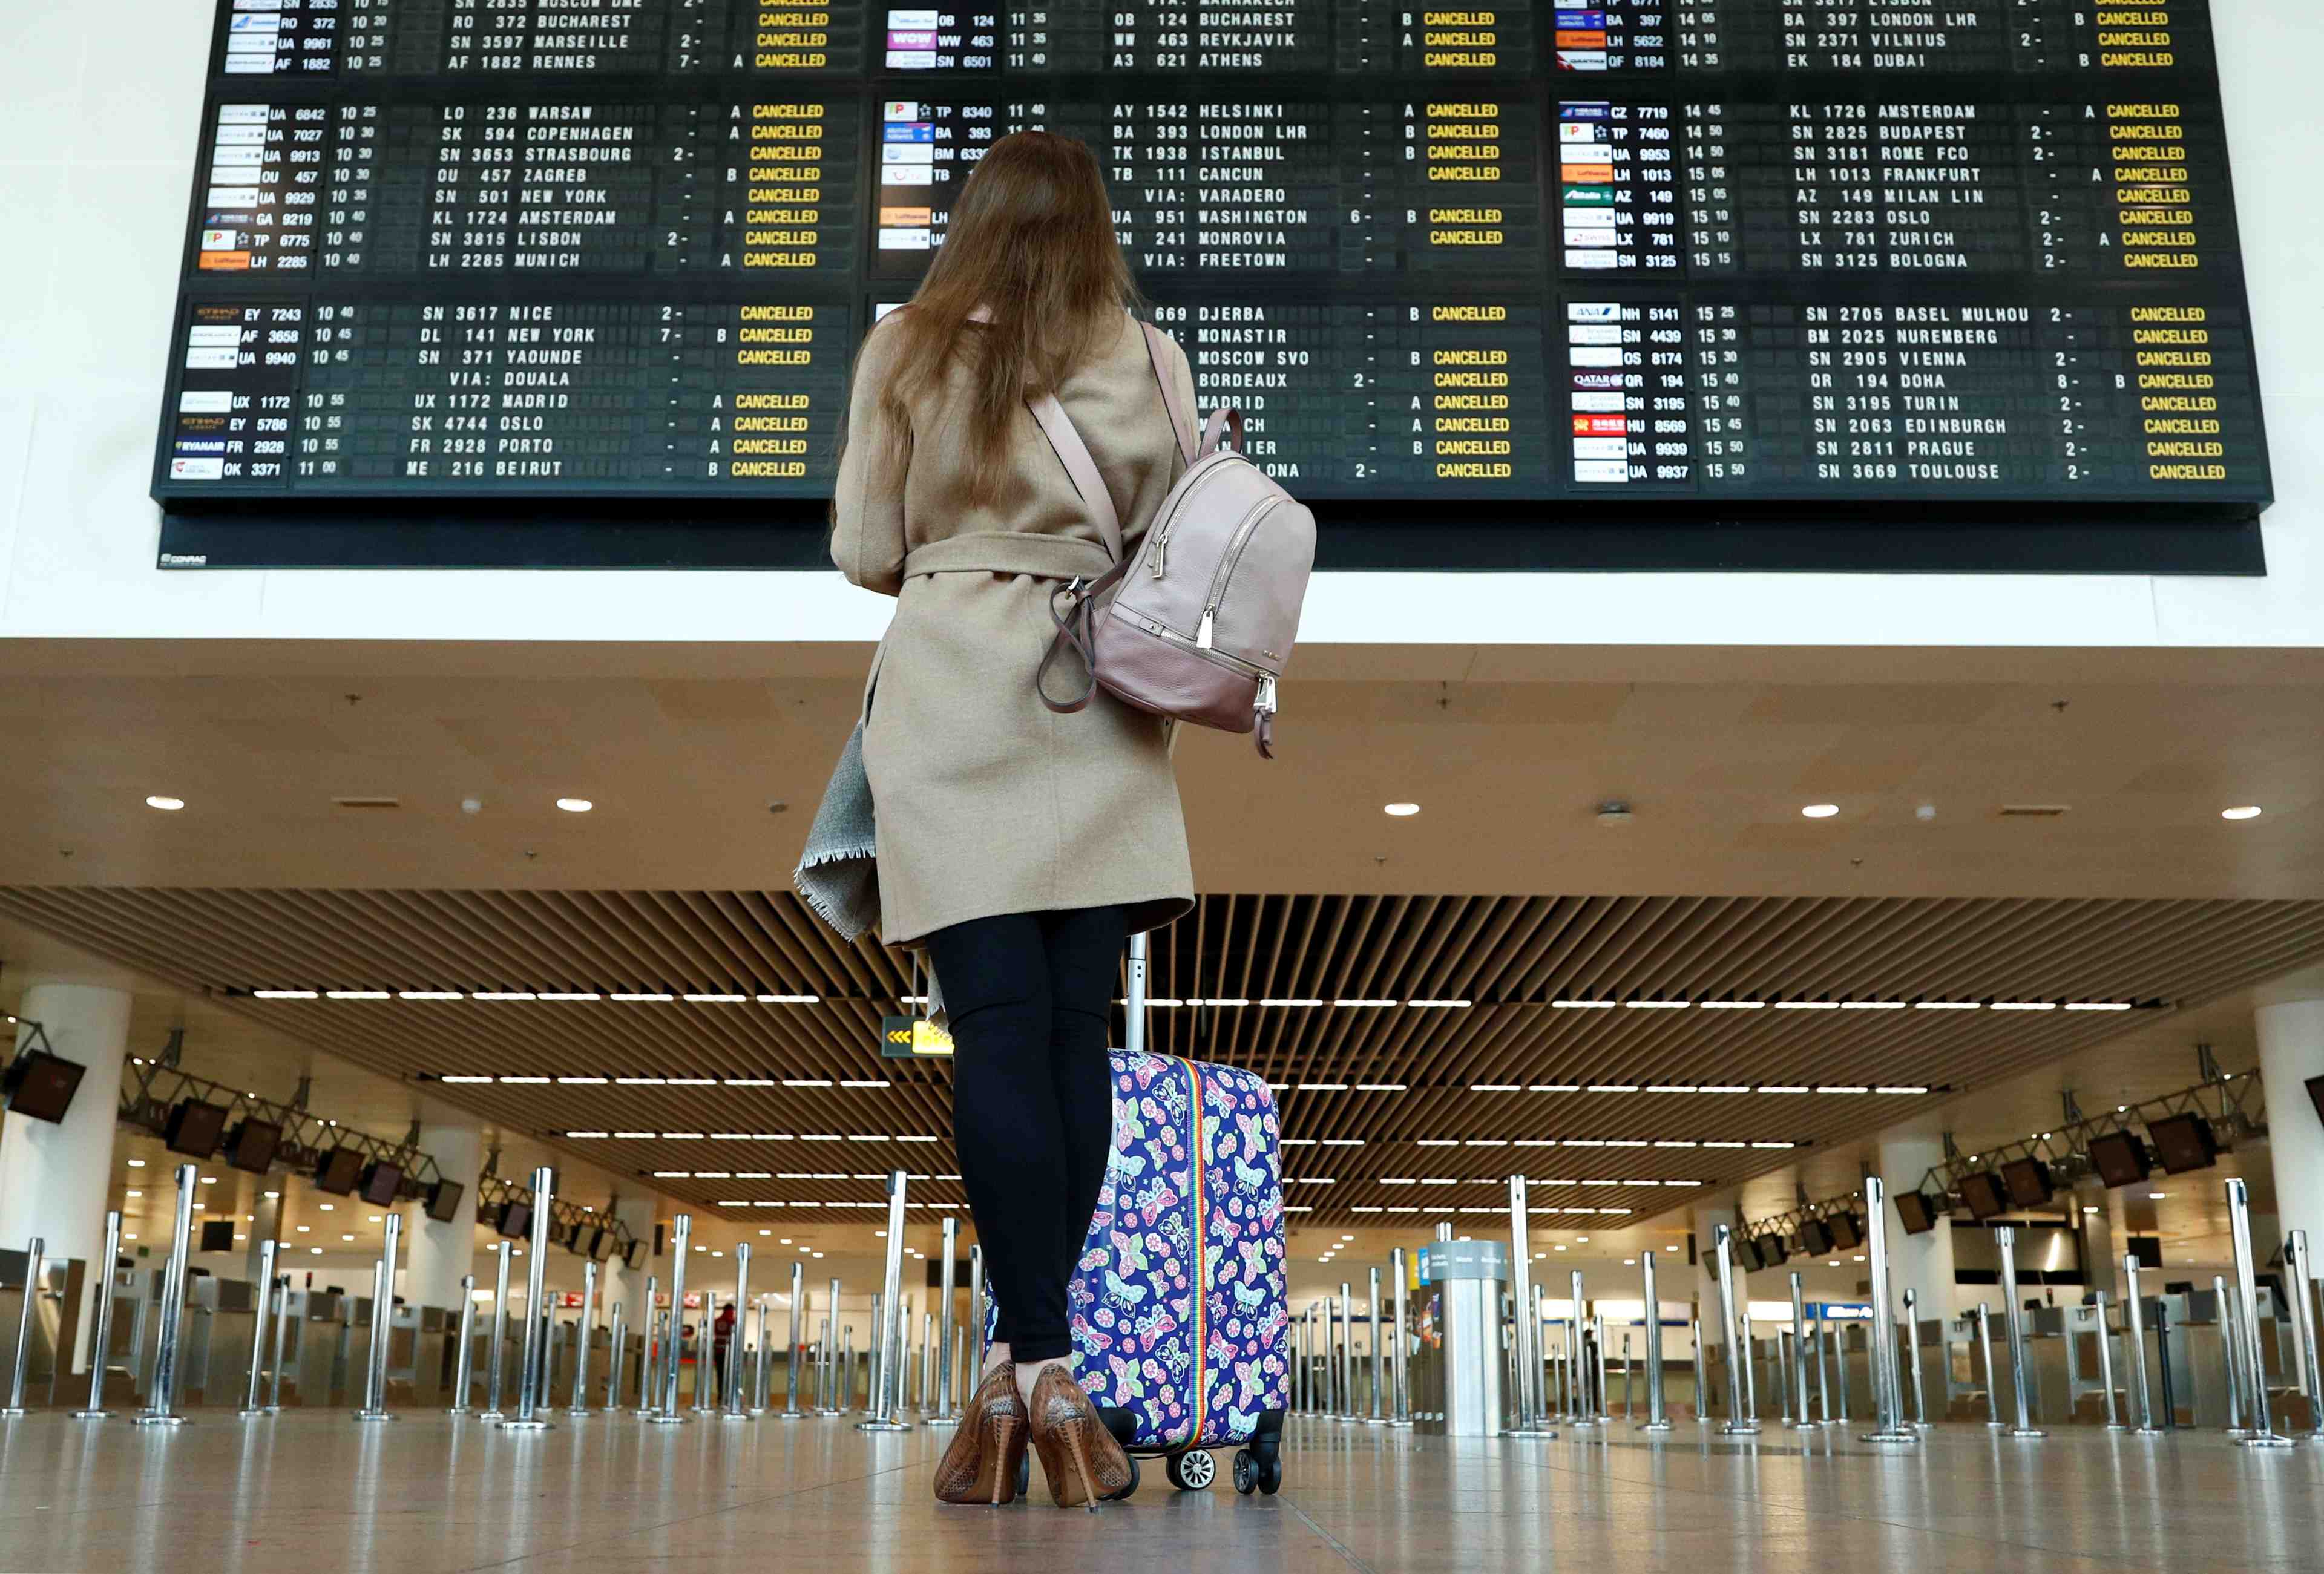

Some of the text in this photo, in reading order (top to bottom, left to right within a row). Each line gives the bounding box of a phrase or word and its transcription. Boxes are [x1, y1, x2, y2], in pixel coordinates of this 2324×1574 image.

[539, 13, 829, 28] BUCHAREST CANCELLED
[1201, 13, 1293, 26] BUCHAREST
[1871, 13, 2168, 26] LONDON LHR CANCELLED
[277, 37, 294, 49] UA
[350, 36, 364, 48] 10
[371, 36, 384, 45] 25
[452, 36, 470, 48] SN
[484, 36, 523, 48] 3597
[535, 35, 628, 48] MARSEILLE
[937, 36, 960, 47] WW
[1201, 33, 1294, 46] REYKJAVIK
[1426, 33, 1495, 45] CANCELLED
[1786, 33, 1945, 47] SN 2371 VILNIUS
[449, 54, 826, 68] AF 1882 RENNES CANCELLED
[1114, 54, 1262, 67] A3 621 ATHENS
[1874, 53, 2173, 67] DUBAI CANCELLED
[530, 107, 591, 119] WARSAW
[1201, 104, 1498, 117] HELSINKI CANCELLED
[1791, 105, 1975, 118] KL 1726 AMSTERDAM
[528, 125, 822, 140] COPENHAGEN CANCELLED
[1201, 125, 1306, 139] LONDON LHR
[1880, 126, 2182, 139] BUDAPEST CANCELLED
[526, 148, 631, 161] STRASBOURG
[1203, 146, 1499, 160] ISTANBUL CANCELLED
[1882, 147, 1968, 160] ROME FCO
[261, 170, 279, 183] OU
[335, 169, 349, 182] 10
[356, 169, 369, 179] 30
[525, 169, 586, 182] ZAGREB
[1200, 168, 1262, 181] CANCUN
[1613, 169, 1630, 181] LH
[1689, 168, 1704, 180] 15
[1712, 167, 1724, 178] 05
[1796, 168, 1816, 181] LH
[1830, 168, 1870, 181] 1013
[1885, 168, 1980, 181] FRANKFURT
[2116, 168, 2187, 181] CANCELLED
[522, 189, 819, 203] NEW YORK CANCELLED
[1200, 189, 1284, 202] VARADERO
[1885, 189, 1983, 203] MILAN LIN
[433, 211, 615, 225] KL 1724 AMSTERDAM
[1112, 209, 1502, 223] UA 951 WASHINGTON CANCELLED
[1888, 211, 1929, 224] OSLO
[519, 232, 580, 246] LISBON
[1200, 232, 1285, 245] MONROVIA
[1891, 232, 2196, 246] ZURICH CANCELLED
[250, 255, 267, 267] LH
[325, 254, 340, 266] 10
[430, 254, 449, 267] LH
[462, 254, 503, 267] 2285
[516, 254, 579, 267] MUNICH
[744, 253, 816, 266] CANCELLED
[1201, 253, 1285, 266] FREETOWN
[1891, 254, 1967, 267] BOLOGNA
[510, 306, 552, 320] NICE
[1200, 307, 1505, 321] DJERBA CANCELLED
[1622, 308, 1640, 320] NH
[1697, 307, 1713, 320] 15
[1721, 307, 1734, 318] 25
[1807, 307, 1827, 321] SN
[1841, 307, 1882, 321] 2705
[1896, 307, 1949, 321] BASEL
[1963, 308, 2028, 321] MULHOU
[2132, 307, 2205, 321] CANCELLED
[508, 328, 812, 343] NEW YORK CANCELLED
[1199, 329, 1286, 343] MONASTIR
[1897, 330, 1997, 343] NUREMBERG
[419, 350, 582, 364] SN 371 YAOUNDE
[1199, 351, 1308, 365] MOSCOW SVO
[1900, 352, 1966, 366] VIENNA
[505, 372, 569, 386] DOUALA
[1199, 373, 1508, 387] BORDEAUX CANCELLED
[1574, 375, 1609, 384] QATAR
[1701, 373, 1718, 387] 15
[1857, 374, 1888, 388] 194
[1902, 374, 1945, 388] DOHA
[2139, 375, 2213, 388] CANCELLED
[232, 395, 250, 408] UX
[308, 394, 323, 407] 10
[331, 394, 344, 405] 55
[503, 394, 568, 408] MADRID
[737, 395, 809, 408] CANCELLED
[1200, 396, 1264, 410] MADRID
[1905, 396, 1958, 410] TURIN
[501, 416, 543, 431] OSLO
[1436, 418, 1509, 432] CANCELLED
[1906, 419, 2219, 433] EDINBURGH CANCELLED
[227, 441, 243, 453] FR
[303, 439, 318, 452] 10
[411, 439, 430, 453] FR
[444, 439, 486, 453] 2928
[499, 439, 553, 453] PORTO
[734, 439, 807, 454] CANCELLED
[1908, 441, 1974, 456] PRAGUE
[497, 461, 562, 476] BEIRUT
[1437, 463, 1511, 477] CANCELLED
[1909, 464, 2225, 479] TOULOUSE CANCELLED
